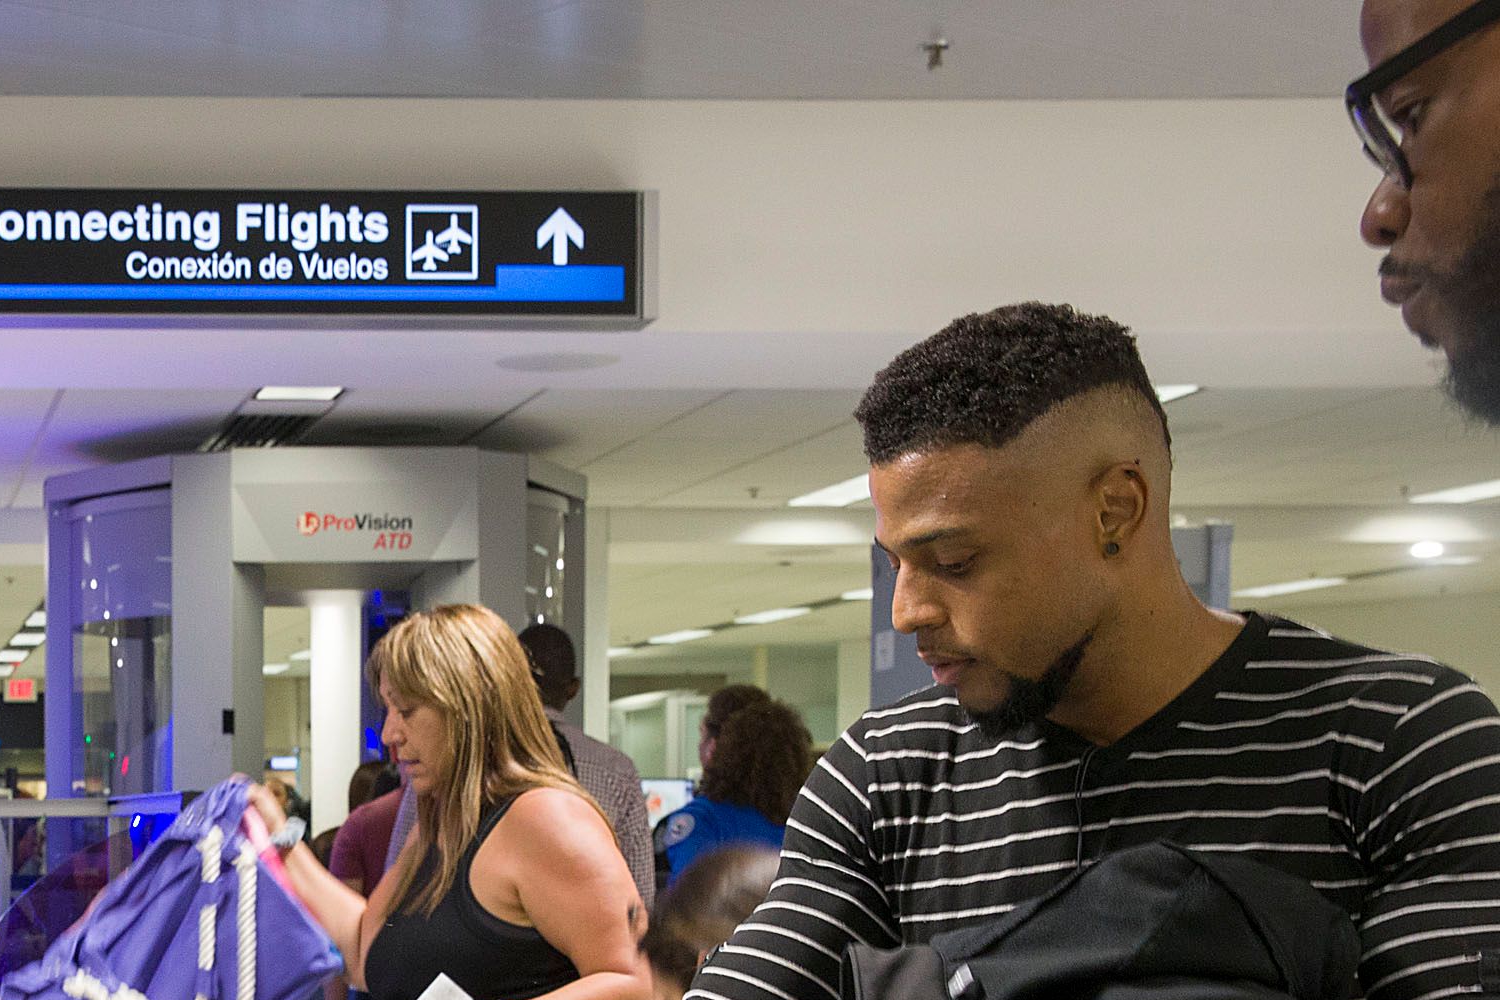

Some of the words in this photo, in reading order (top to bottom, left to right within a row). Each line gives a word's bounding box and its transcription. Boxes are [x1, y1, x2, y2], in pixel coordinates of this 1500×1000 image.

[236, 203, 389, 252] Flights
[125, 251, 252, 280] Conexión
[258, 252, 293, 280] de
[298, 252, 389, 280] Vuelos
[322, 513, 413, 531] ProVision
[373, 533, 413, 550] ATD
